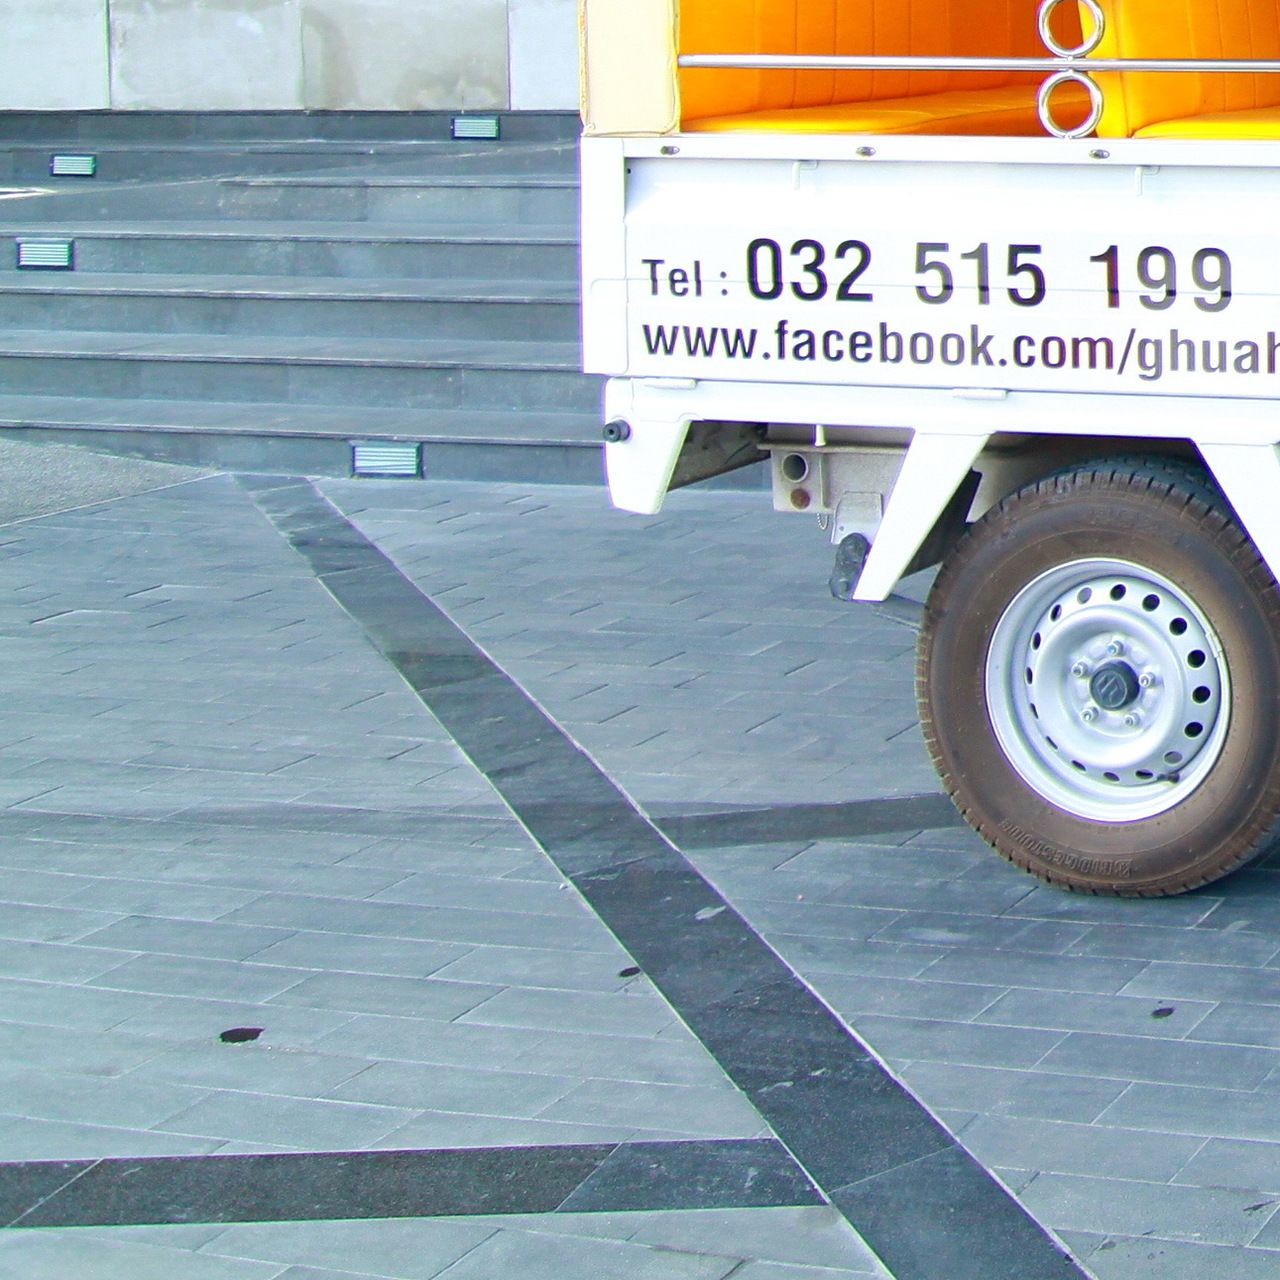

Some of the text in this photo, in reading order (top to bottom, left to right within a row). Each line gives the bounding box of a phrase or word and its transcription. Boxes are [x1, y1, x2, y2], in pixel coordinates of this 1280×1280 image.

[641, 258, 702, 297] Tel
[746, 237, 874, 303] 032
[915, 241, 1047, 308] 515
[1089, 244, 1233, 313] 199
